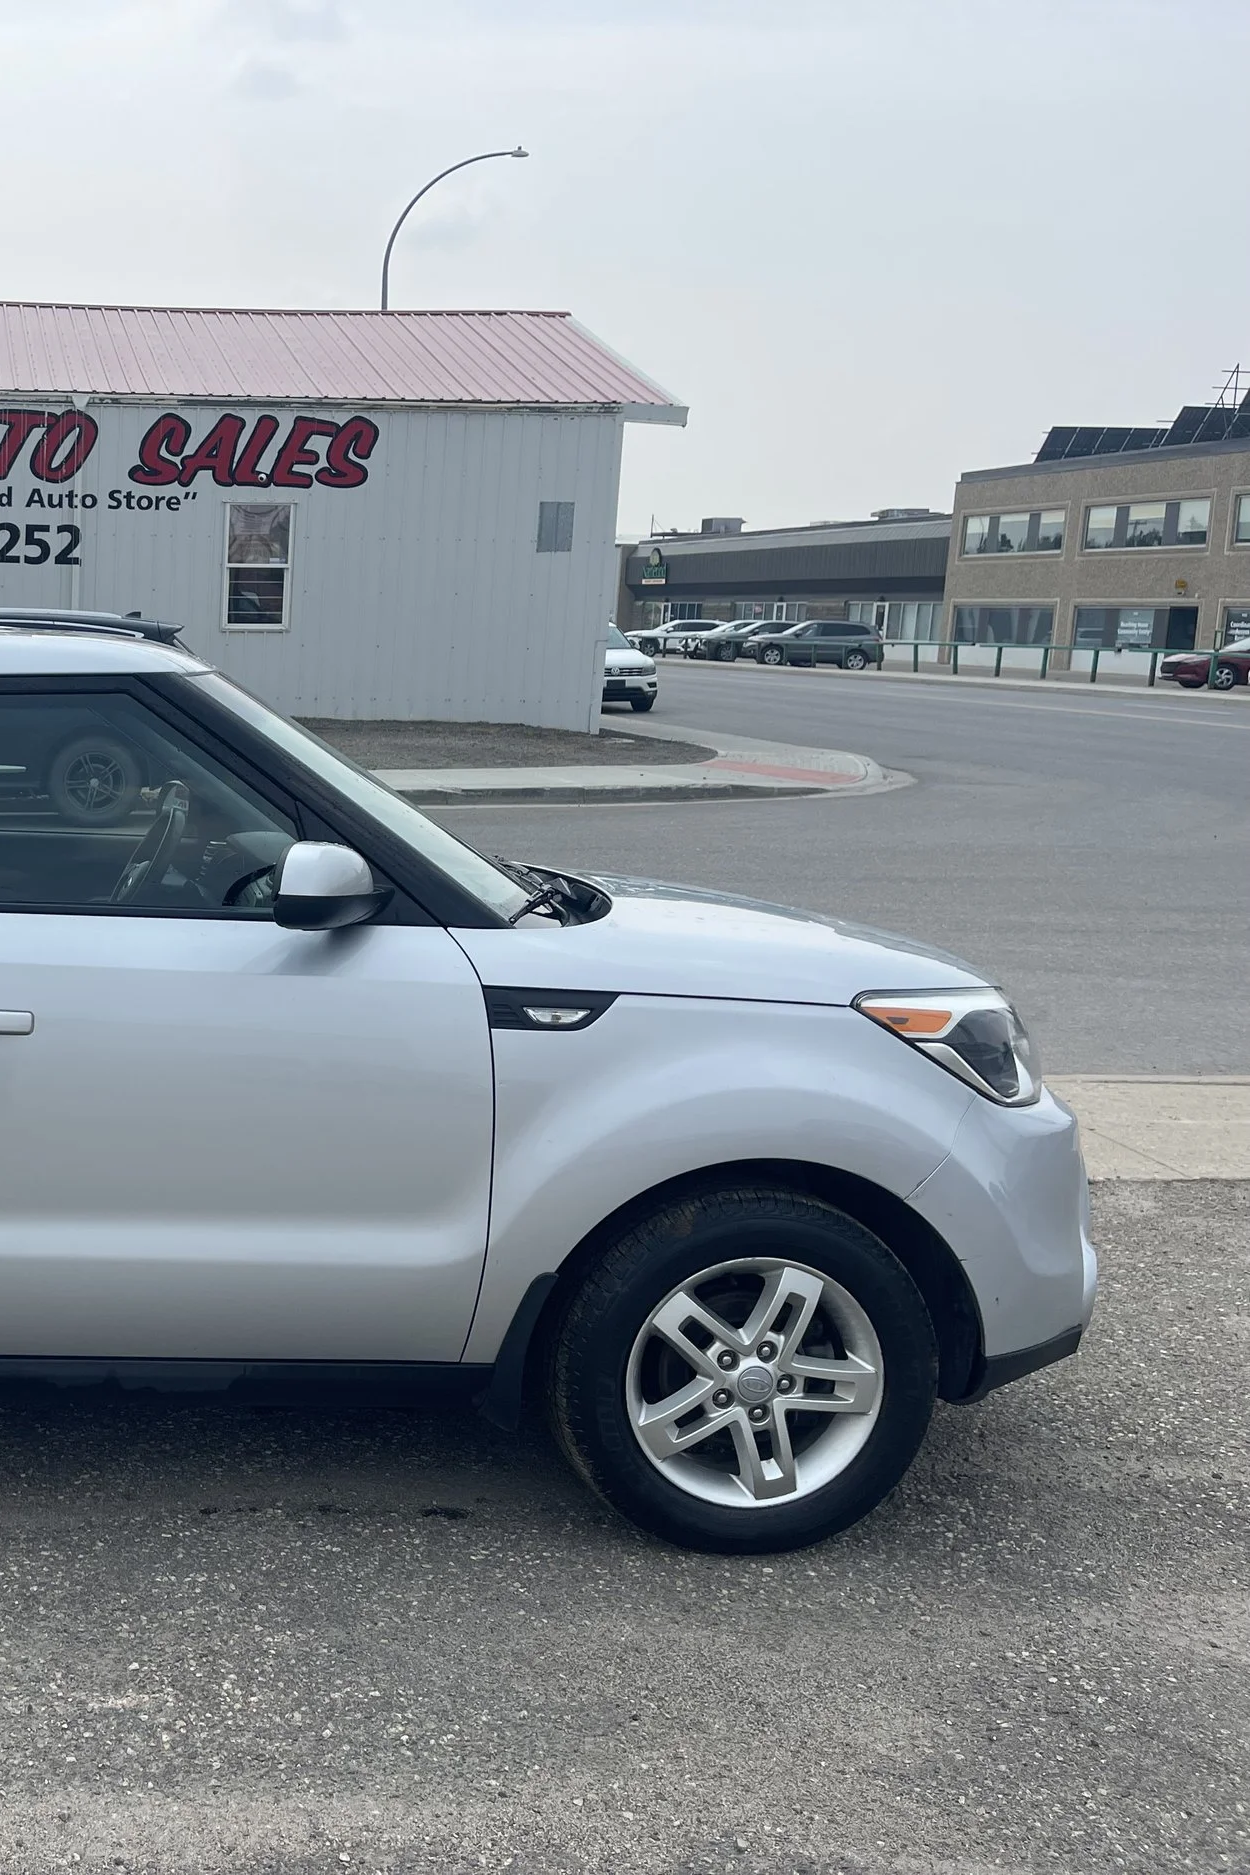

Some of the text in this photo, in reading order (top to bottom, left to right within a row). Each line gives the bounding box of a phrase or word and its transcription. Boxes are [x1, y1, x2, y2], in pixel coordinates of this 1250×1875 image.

[128, 412, 380, 489] SALES
[25, 487, 98, 510] Auto
[107, 489, 199, 512] Store"
